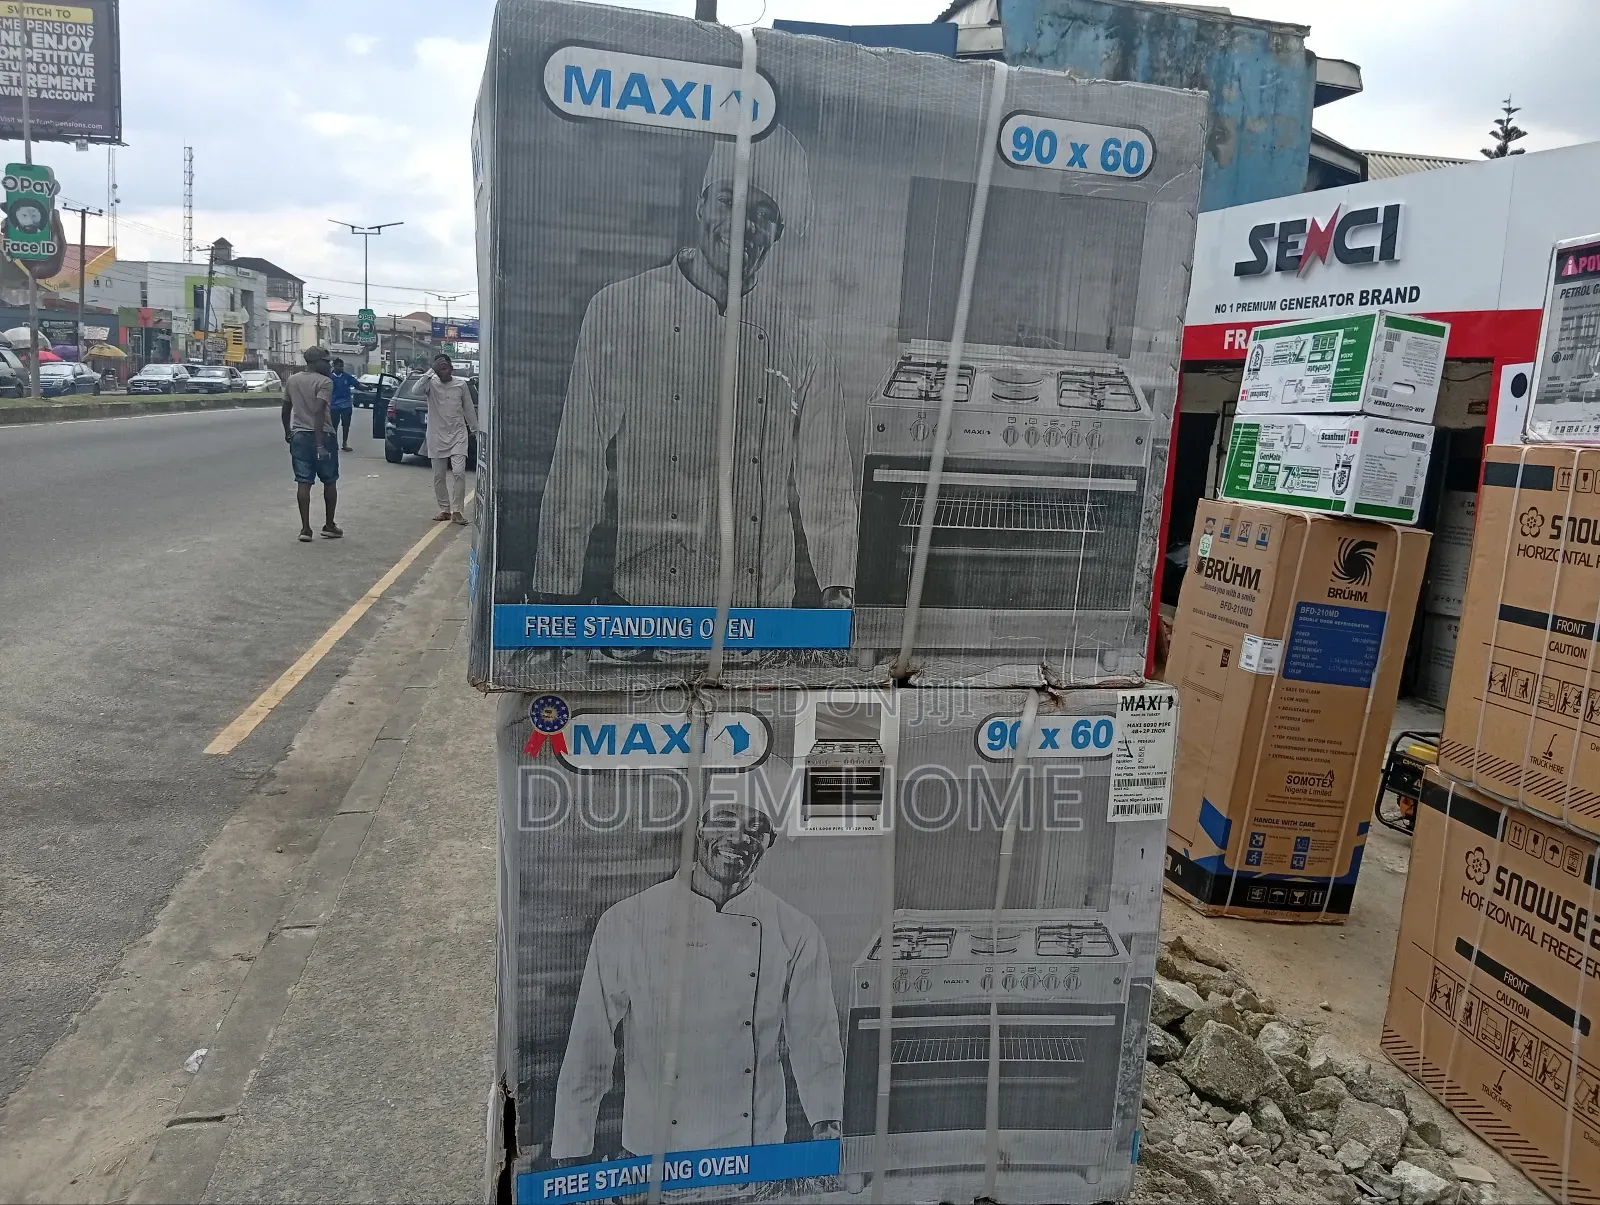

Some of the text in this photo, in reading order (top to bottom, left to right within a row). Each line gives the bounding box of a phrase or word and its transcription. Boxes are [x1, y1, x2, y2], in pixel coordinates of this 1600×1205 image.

[56, 9, 71, 19] TO
[27, 20, 94, 37] PENSIONS
[32, 32, 93, 52] ENJOY
[40, 63, 57, 75] ON
[61, 65, 94, 78] YOUR
[40, 90, 95, 102] ACCOUNT
[563, 64, 712, 121] MAXI
[1011, 125, 1145, 175] 90 x 60
[2, 175, 56, 197] OPay
[3, 240, 56, 254] Face ID
[1234, 203, 1400, 278] SENCI
[1214, 285, 1421, 314] NO 1 PREMIUM GENERATOR BRAND
[1560, 285, 1591, 299] PETROL
[1223, 329, 1249, 350] FR
[1321, 432, 1346, 441] Scanfrost
[1374, 427, 1425, 439] AIR-CONDITIONER
[1259, 452, 1281, 461] GenMate
[1517, 543, 1593, 568] HORIZONTAL
[1327, 586, 1367, 603] BRÜHM
[1220, 600, 1253, 617] BFD-210MD
[1300, 606, 1339, 618] BFD-210MD
[525, 616, 755, 639] FREE STANDING OEN
[1556, 619, 1587, 635] FRONT
[1549, 640, 1588, 660] CAUTION
[1121, 694, 1163, 711] MAXI
[1038, 727, 1061, 750] x
[1071, 719, 1114, 750] 60
[1530, 755, 1564, 775] TRUCK HERE
[1284, 785, 1332, 797] Nigeria Limited
[1286, 775, 1334, 789] SOMOTEX
[1253, 816, 1280, 825] HANDLE
[1299, 820, 1316, 828] CARE
[1461, 886, 1538, 945] HORIZONTAL
[1503, 971, 1529, 995] FRONT
[1495, 989, 1530, 1019] CAUTION
[1482, 1083, 1513, 1112] TRUCK HERE
[543, 1172, 590, 1199] FREE
[699, 1154, 750, 1177] OVEN
